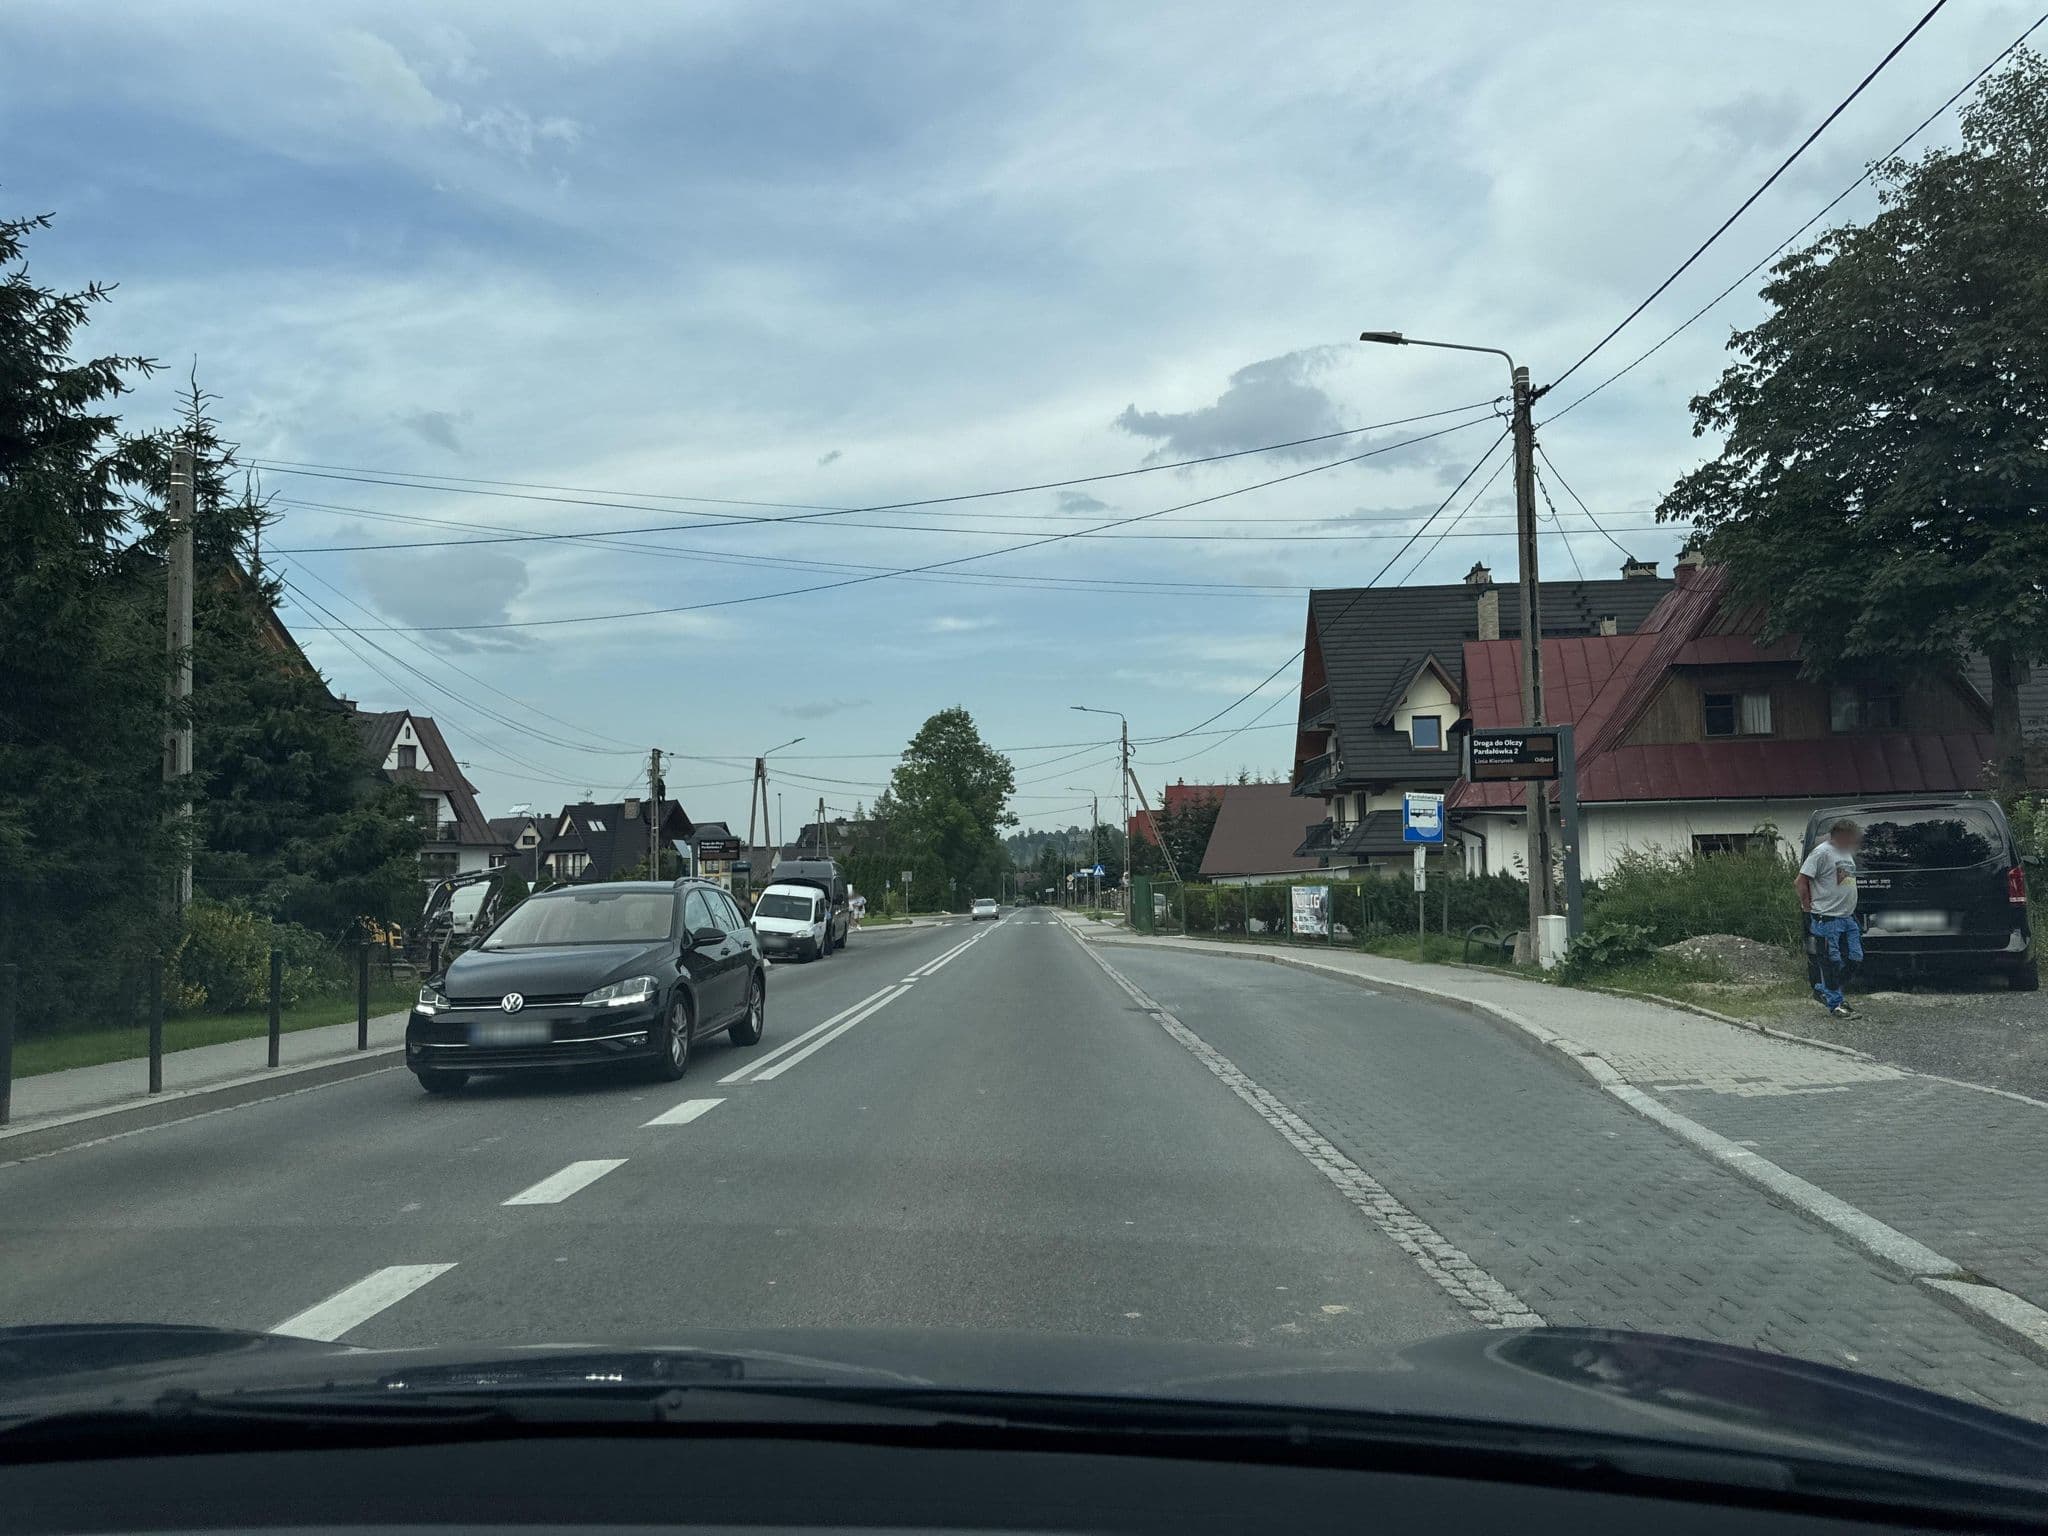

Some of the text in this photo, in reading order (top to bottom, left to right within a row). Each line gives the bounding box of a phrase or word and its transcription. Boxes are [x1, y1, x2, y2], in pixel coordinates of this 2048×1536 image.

[1473, 740, 1494, 748] Droga
[1504, 739, 1523, 747] Olczy
[1473, 747, 1519, 755] Pardałówka 2
